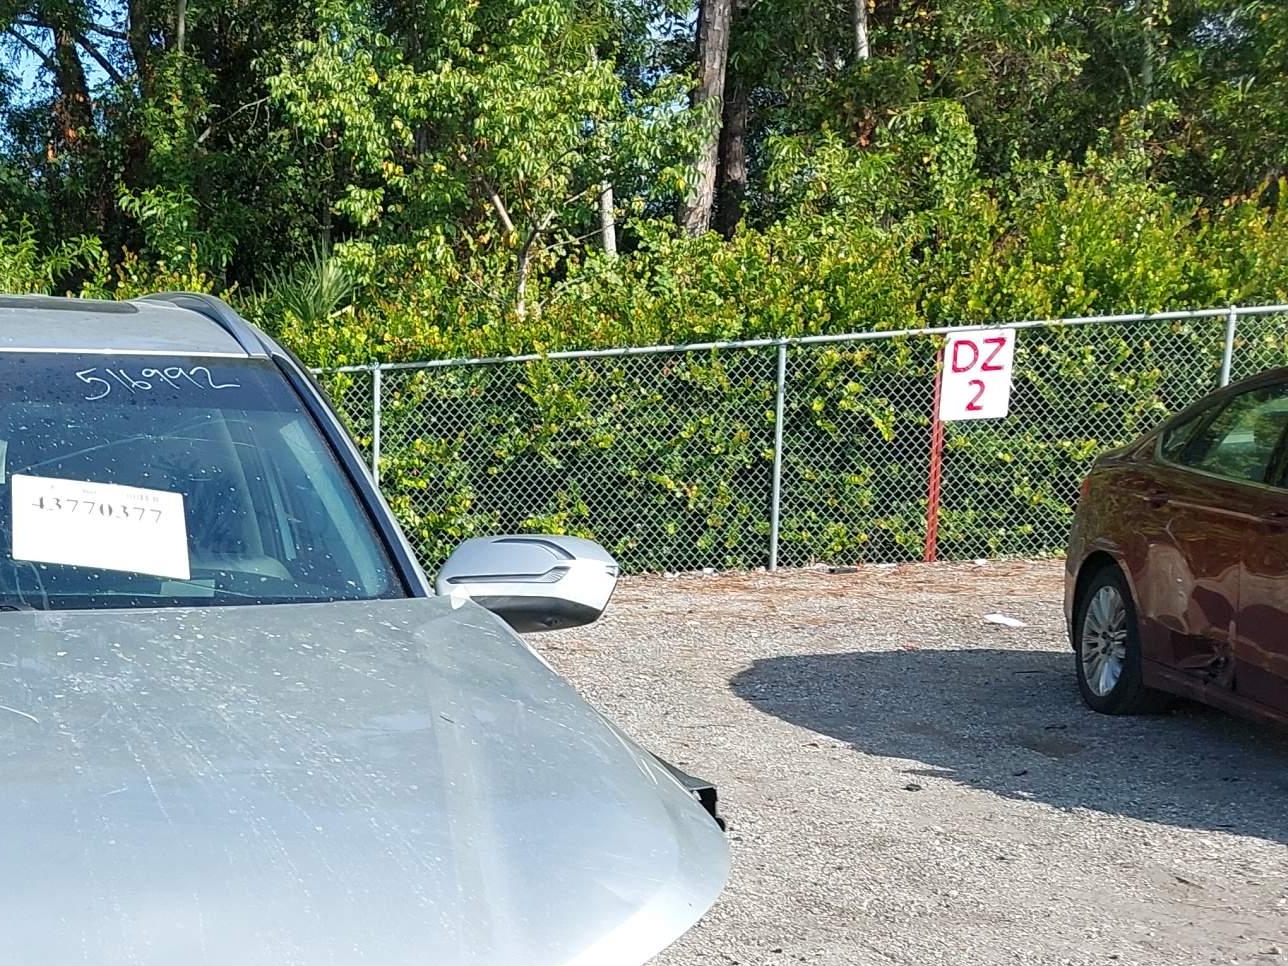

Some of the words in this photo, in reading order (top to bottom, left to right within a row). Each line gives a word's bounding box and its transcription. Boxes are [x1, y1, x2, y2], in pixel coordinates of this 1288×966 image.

[951, 337, 1007, 373] DZ
[75, 366, 241, 401] 516992
[965, 379, 986, 411] 2
[31, 495, 164, 524] 43770377
